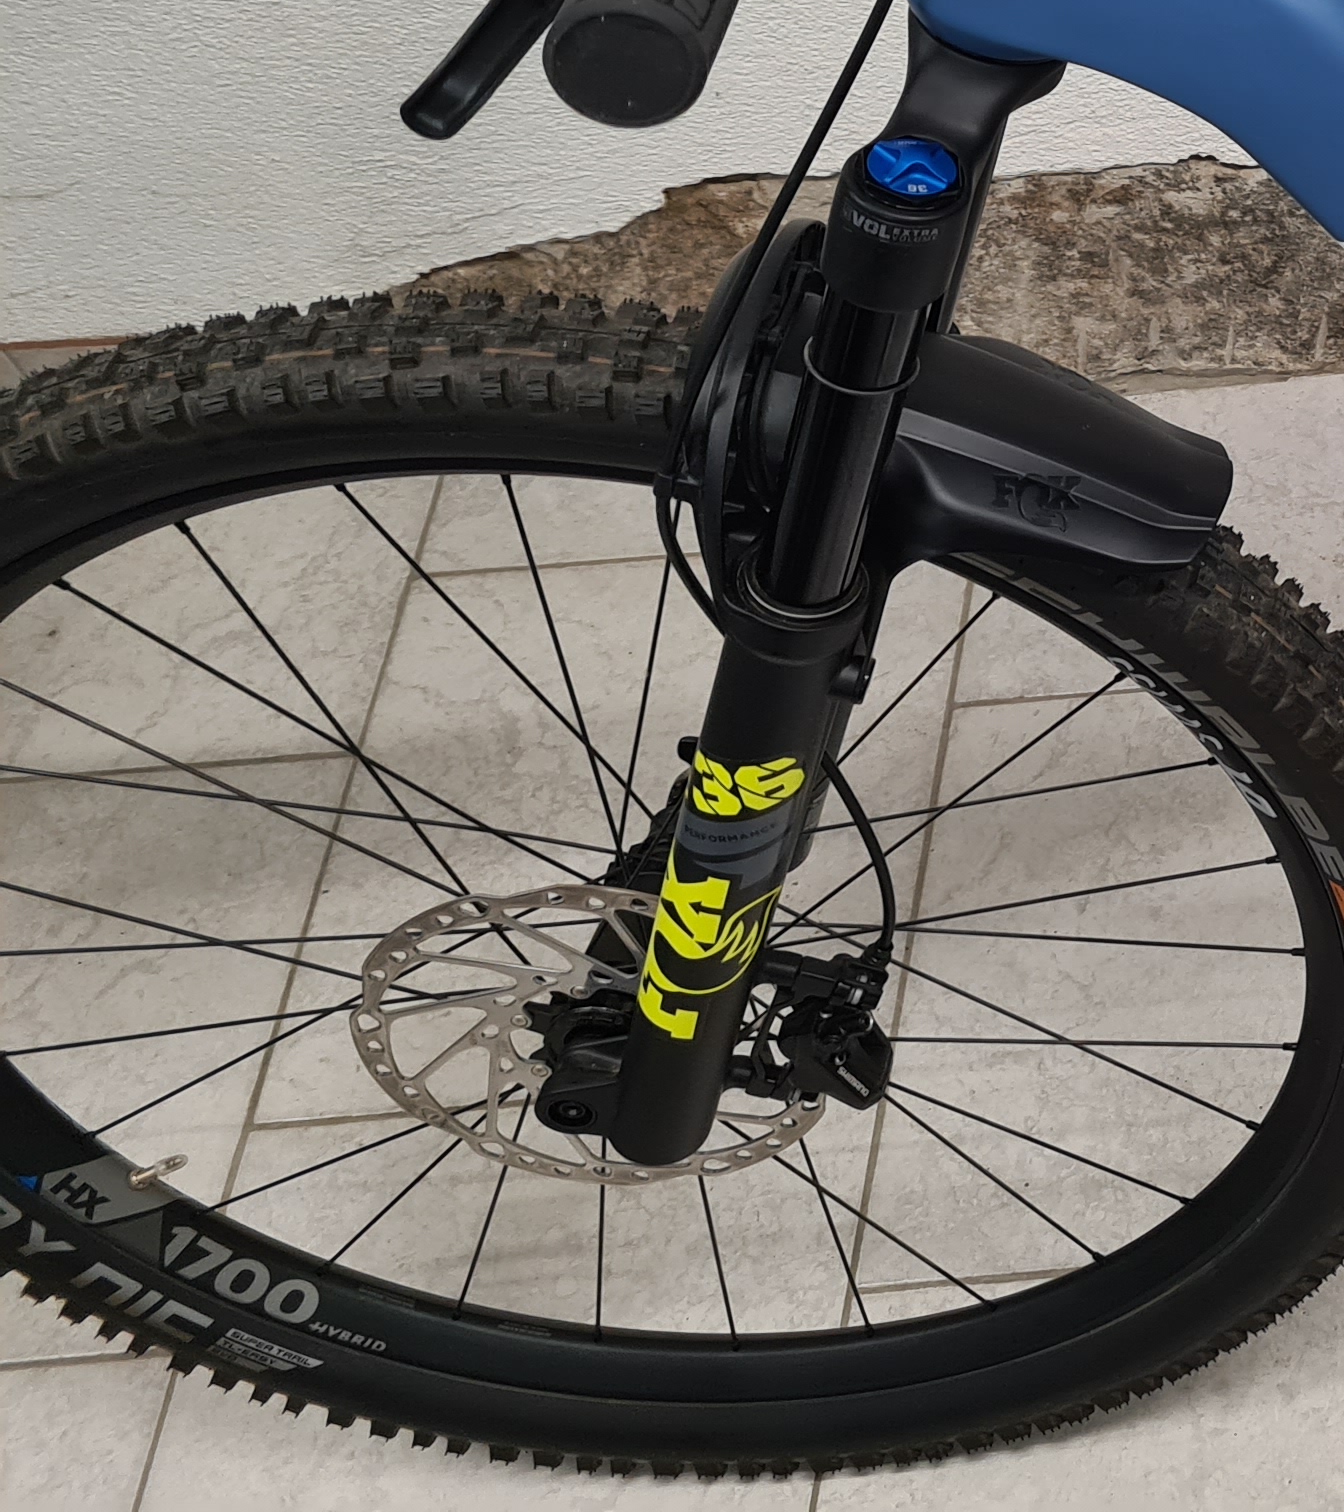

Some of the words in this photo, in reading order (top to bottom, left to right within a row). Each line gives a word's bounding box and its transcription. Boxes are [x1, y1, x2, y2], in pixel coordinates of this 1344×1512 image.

[690, 750, 806, 817] 36
[837, 1066, 870, 1097] SHIMANO
[50, 1172, 112, 1221] HX
[163, 1226, 320, 1325] 1700
[230, 1330, 275, 1353] SUPER
[275, 1348, 312, 1367] TRAIL
[308, 1322, 388, 1353] HYBRID
